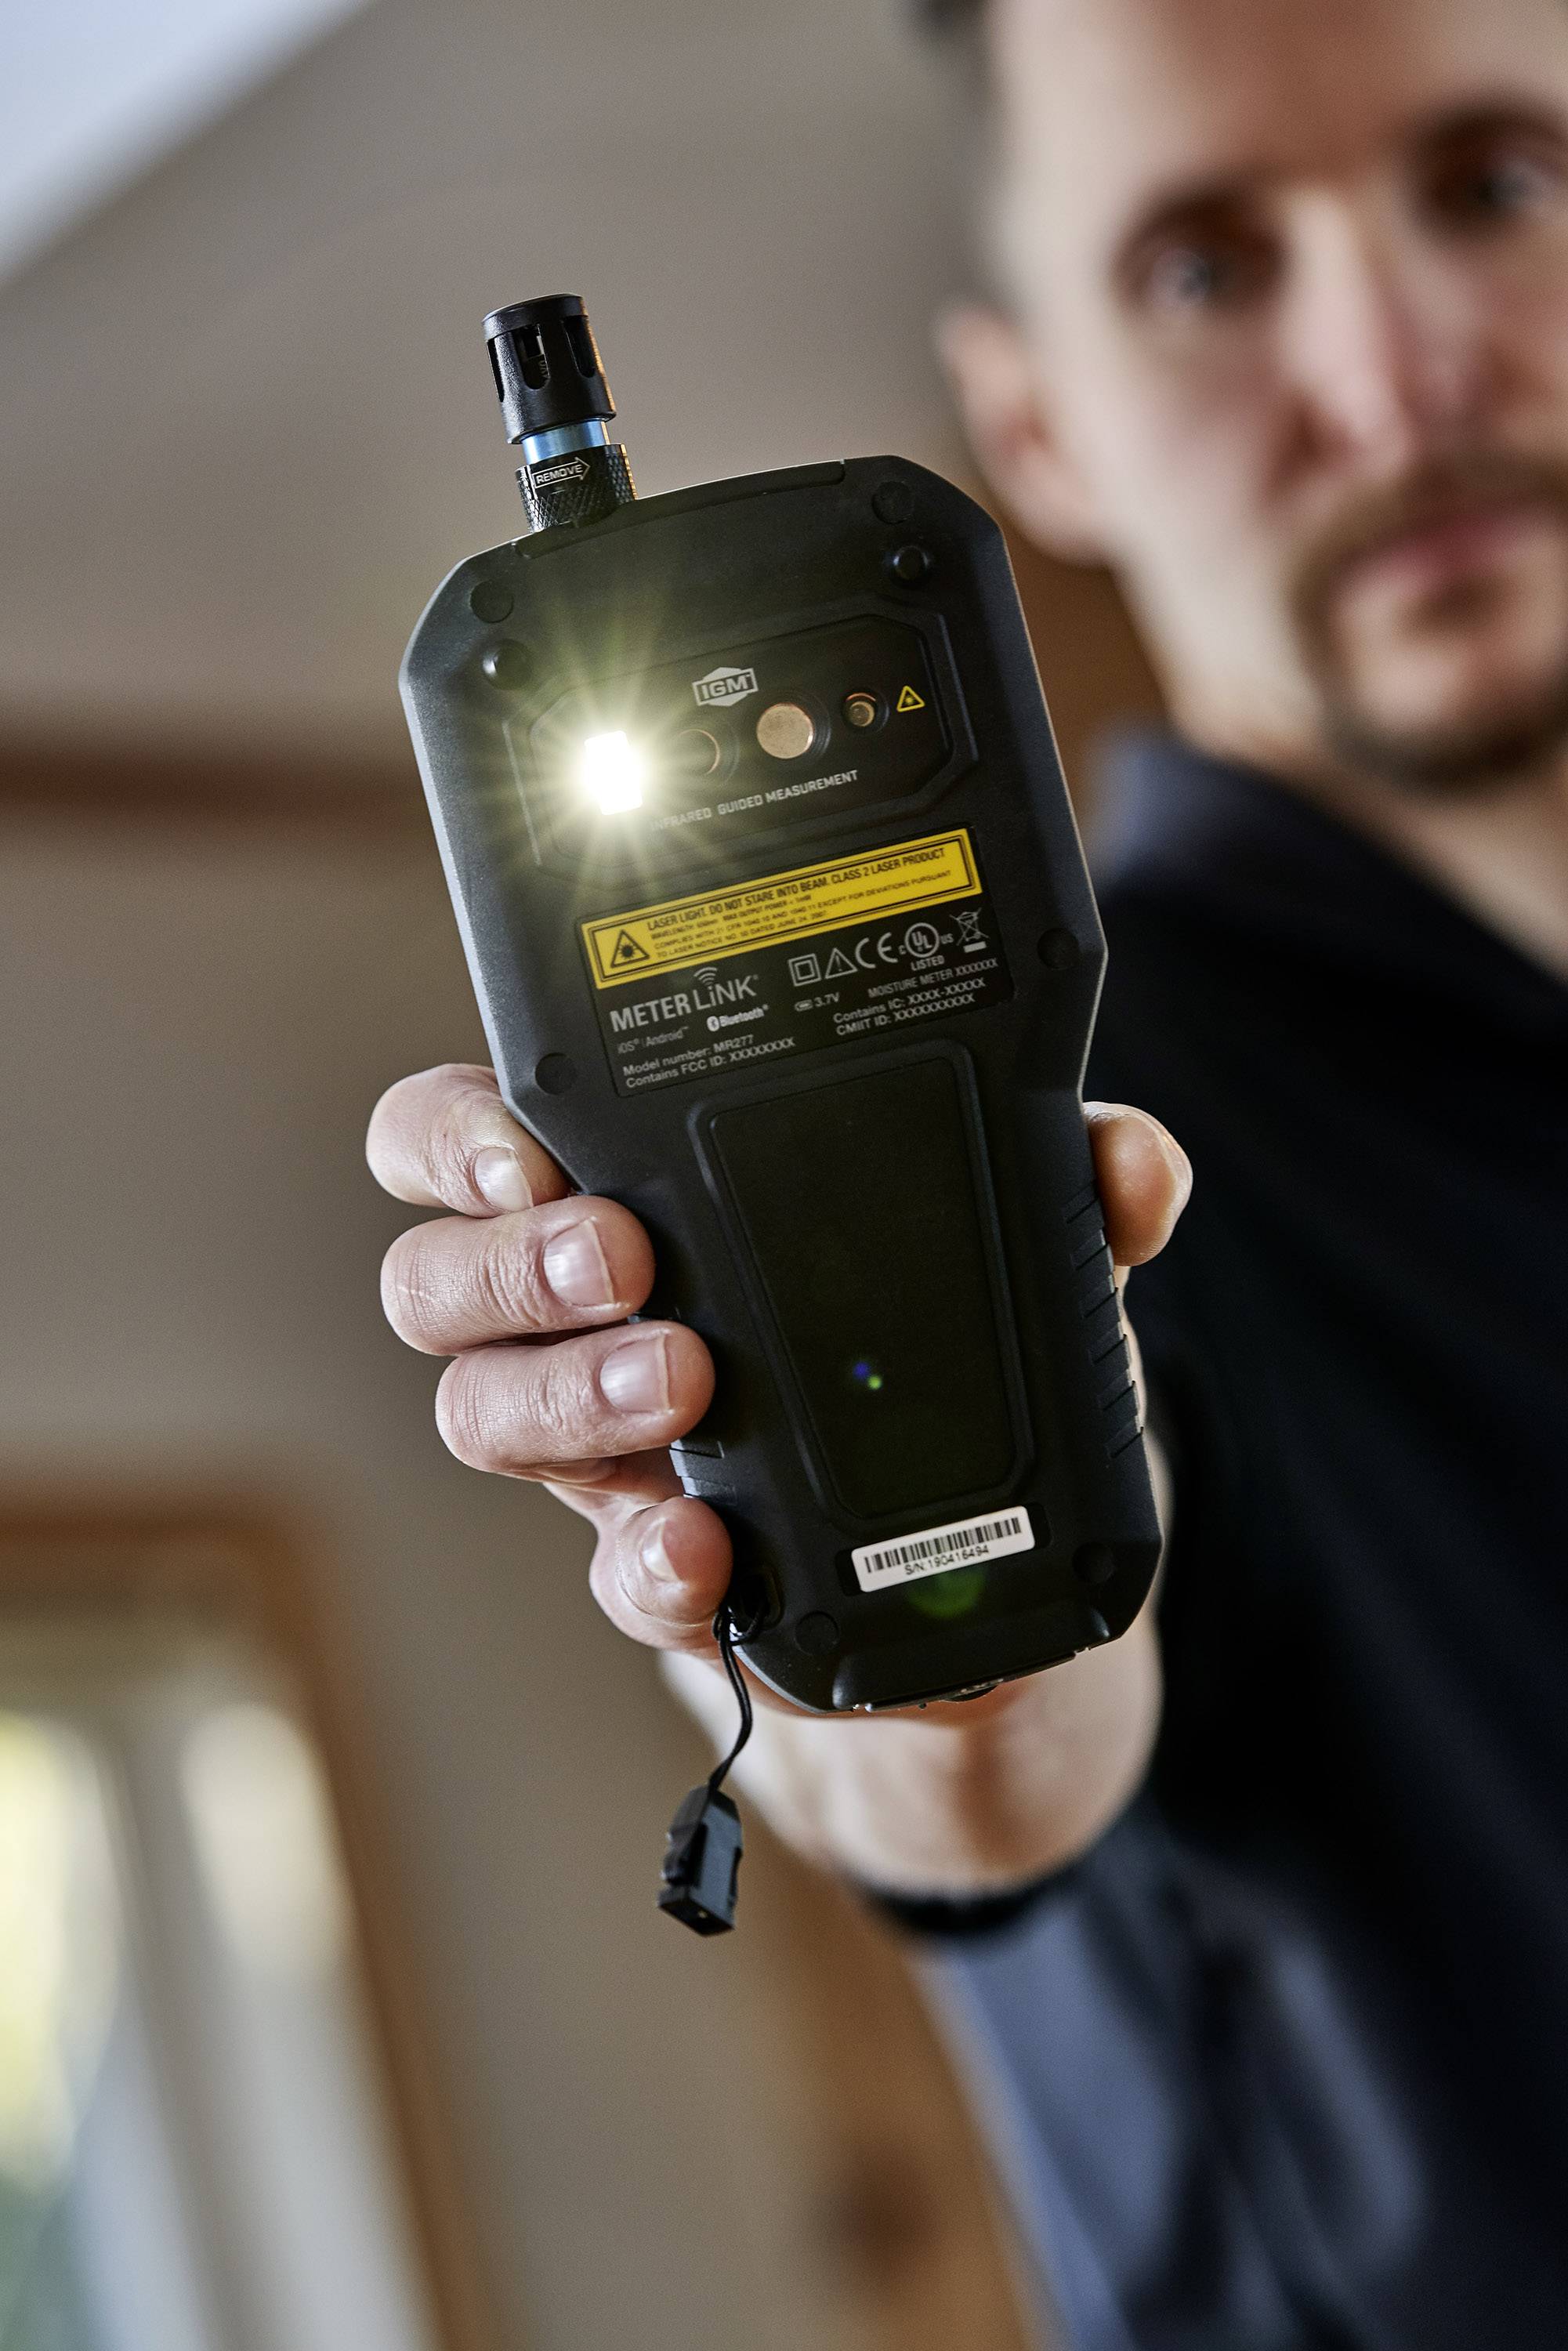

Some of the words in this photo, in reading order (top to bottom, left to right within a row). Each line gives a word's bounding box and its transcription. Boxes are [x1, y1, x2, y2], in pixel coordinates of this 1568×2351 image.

[536, 465, 582, 484] REMOVE
[701, 675, 748, 699] IGM
[716, 794, 763, 815] GUIDED
[764, 770, 860, 803] MEASUREMENT
[646, 915, 678, 930] LASER
[708, 903, 722, 915] DO
[724, 898, 743, 911] NOT
[744, 890, 774, 905] STARE
[776, 884, 798, 897] INTO
[831, 868, 860, 884] CLASS
[862, 866, 869, 876] 2
[871, 858, 900, 874] LASER
[902, 847, 944, 866] PRODUCT
[848, 891, 864, 900] FOR
[910, 954, 944, 971] LISTED
[867, 977, 918, 998] MOISTURE
[919, 968, 954, 985] METER
[813, 992, 841, 1007] 3.7V
[832, 1002, 886, 1023] Contains
[887, 997, 905, 1009] IC:
[874, 1012, 891, 1026] ID:
[622, 1058, 660, 1076] Model
[661, 1045, 712, 1066] number:
[712, 1034, 755, 1052] MR277
[625, 1066, 679, 1088] Contains
[680, 1059, 707, 1074] FCC
[709, 1053, 726, 1067] ID:
